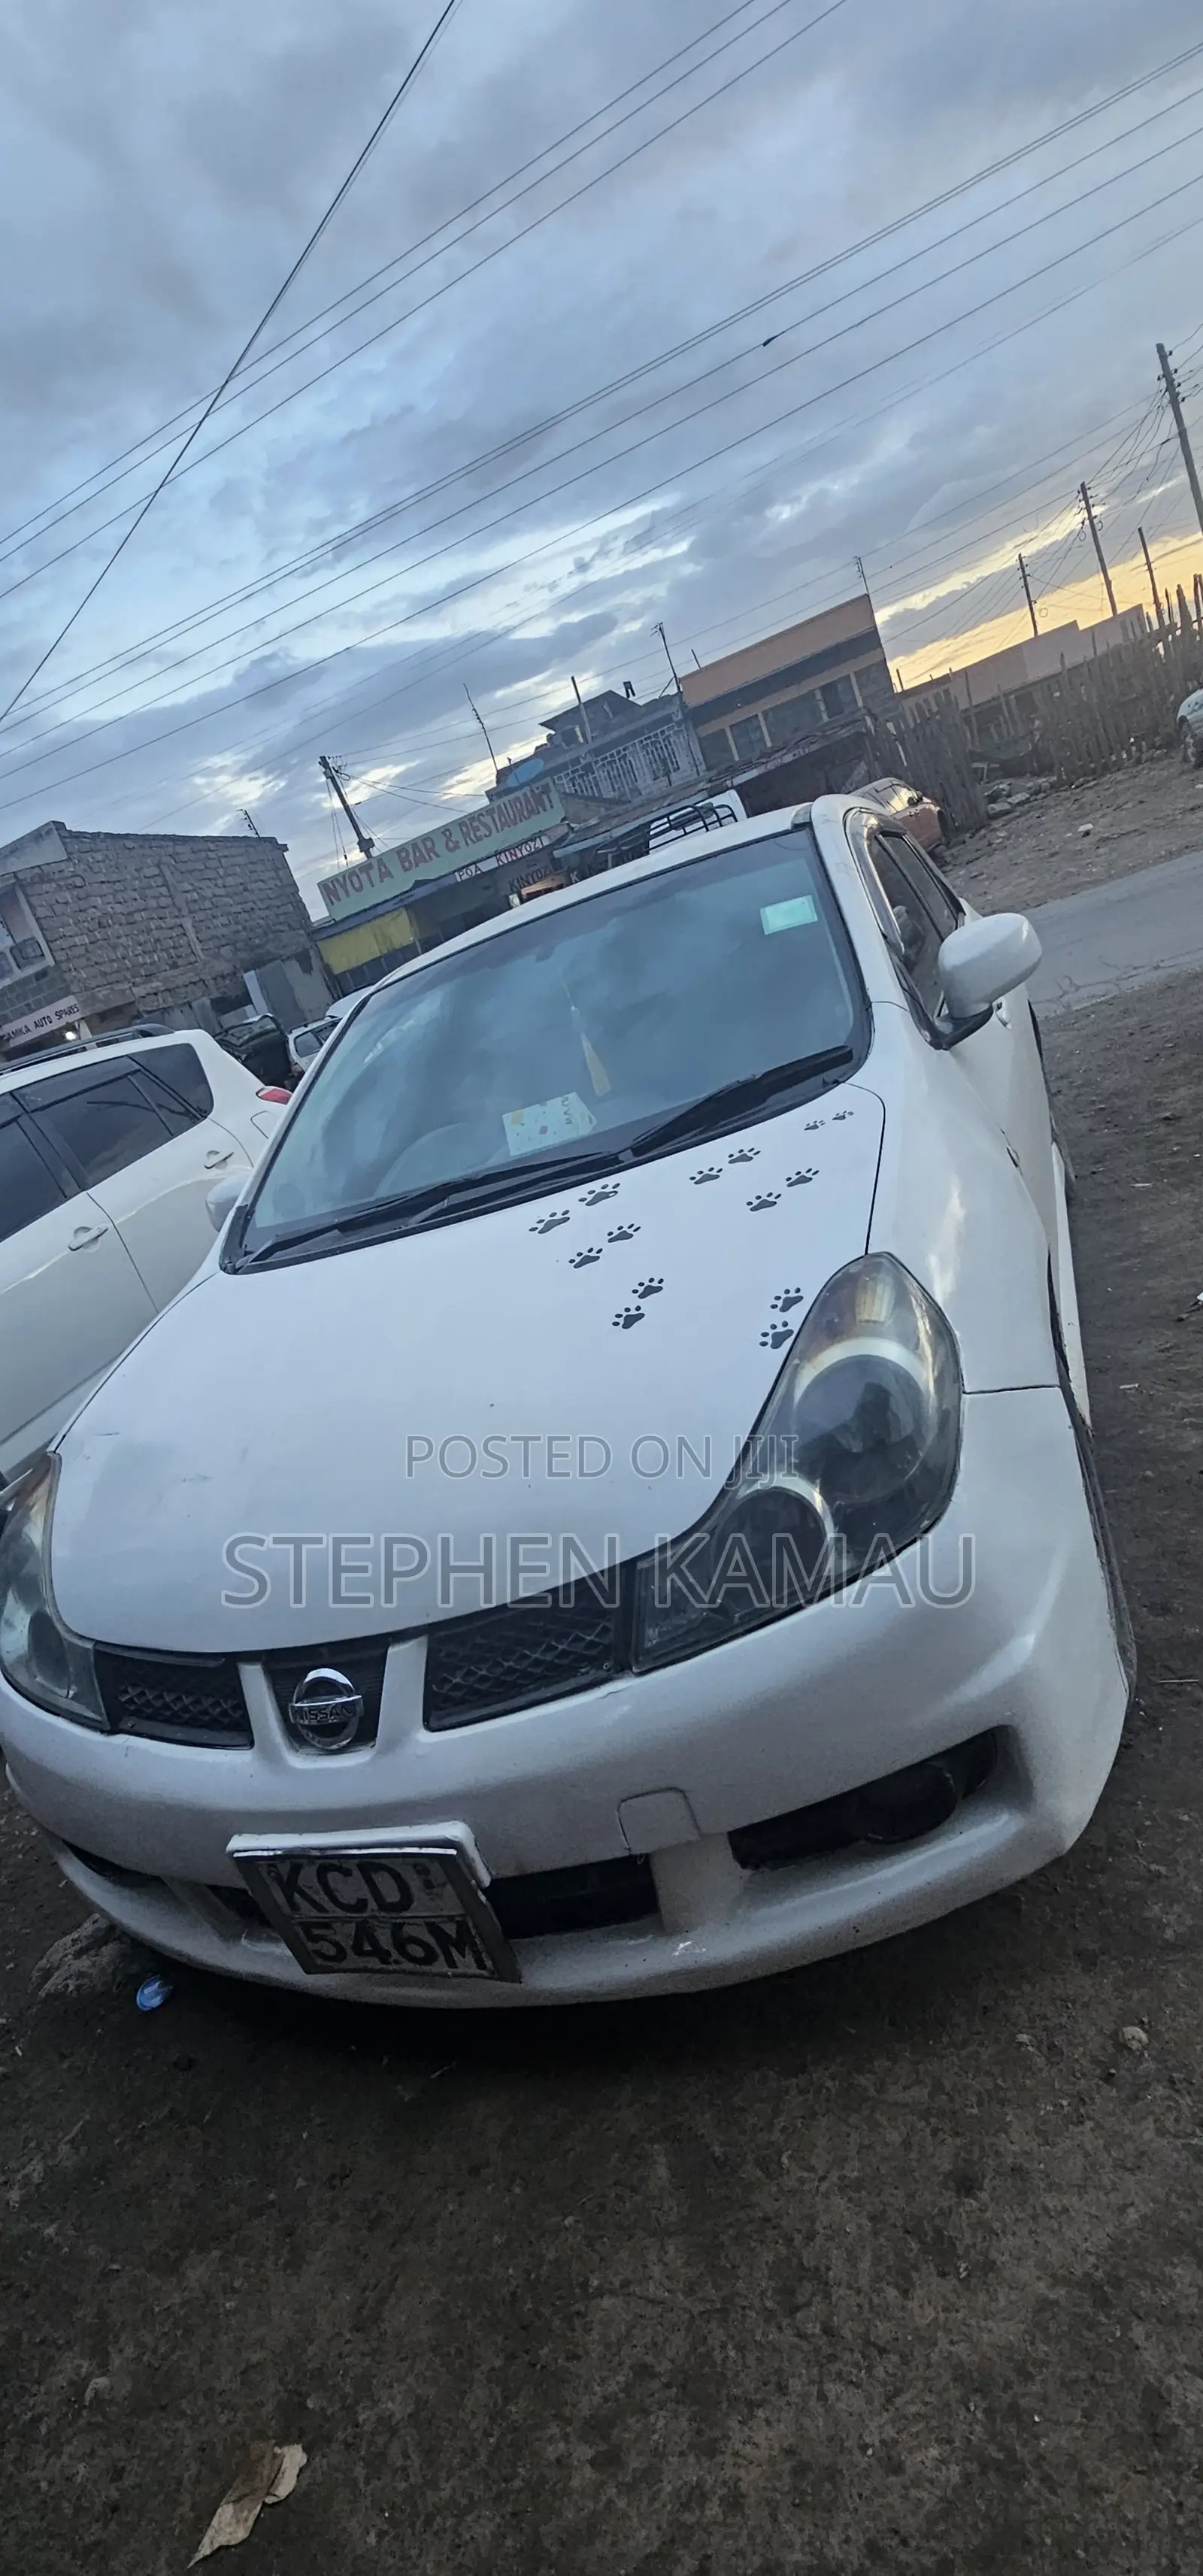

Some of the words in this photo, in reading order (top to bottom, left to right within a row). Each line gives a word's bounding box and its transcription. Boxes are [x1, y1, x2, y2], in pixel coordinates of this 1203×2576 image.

[323, 859, 395, 905] NYOTA
[395, 836, 441, 873] BAR
[441, 827, 462, 853] &
[458, 782, 555, 847] RESTAURANT
[495, 835, 547, 865] KINYOZI
[33, 1014, 53, 1029] AUTO
[266, 1861, 414, 1914] KCD
[300, 1920, 487, 1971] 546M
